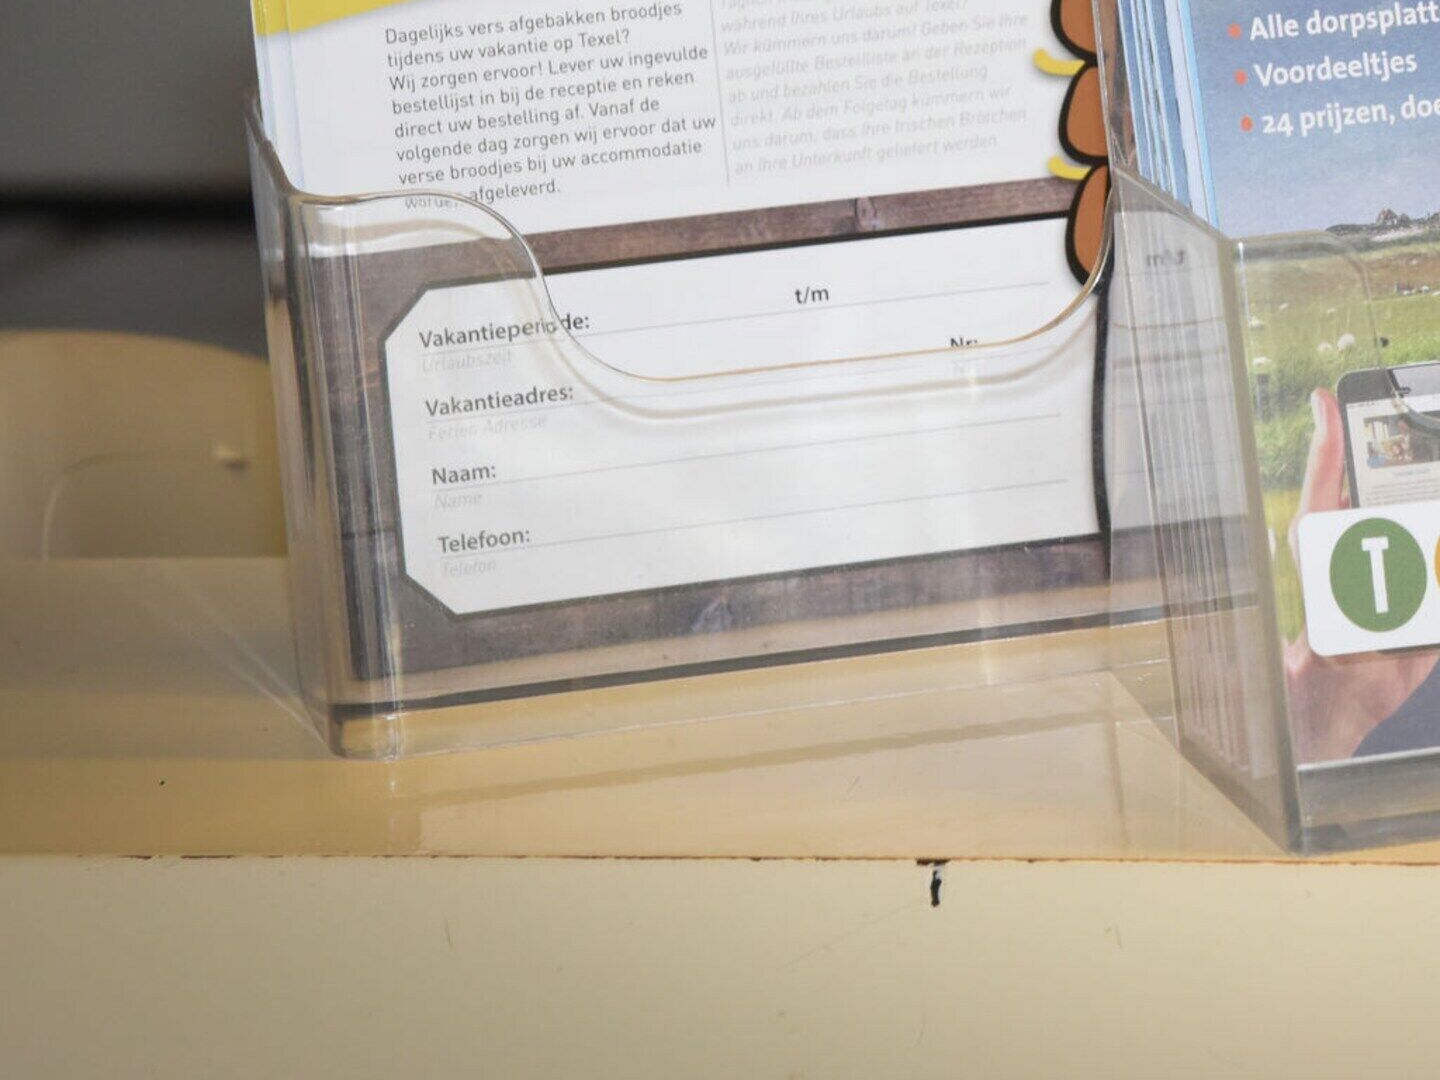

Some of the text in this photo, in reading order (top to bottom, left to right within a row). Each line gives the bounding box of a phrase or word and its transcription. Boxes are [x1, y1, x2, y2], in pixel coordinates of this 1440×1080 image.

[384, 2, 682, 45] Dagelijks vers afgebakken broodjes
[1249, 13, 1298, 40] Alle
[386, 27, 629, 70] tijdens uw vakantie op Texel?
[388, 45, 708, 92] Wij zorgen ervoor! Lever uw ingevulde
[1252, 50, 1417, 86] Voordeeltjes
[391, 72, 694, 114] bestellijst in bij de receptie en reken
[394, 97, 659, 138] direct uw bestelling af. Vanaf de
[1261, 112, 1293, 136] 24
[1299, 101, 1395, 137] prijzen,
[395, 117, 716, 163] volgende dag zorgen wij ervoor dat uw
[398, 141, 702, 184] verse broodjes bij uw accommodatie
[468, 179, 560, 203] afgeleverd.
[418, 286, 829, 349] Vakantieperiode: t/m
[424, 386, 574, 417] Vakantieadres:
[431, 465, 496, 485] Naam:
[437, 529, 530, 554] Telefoon:
